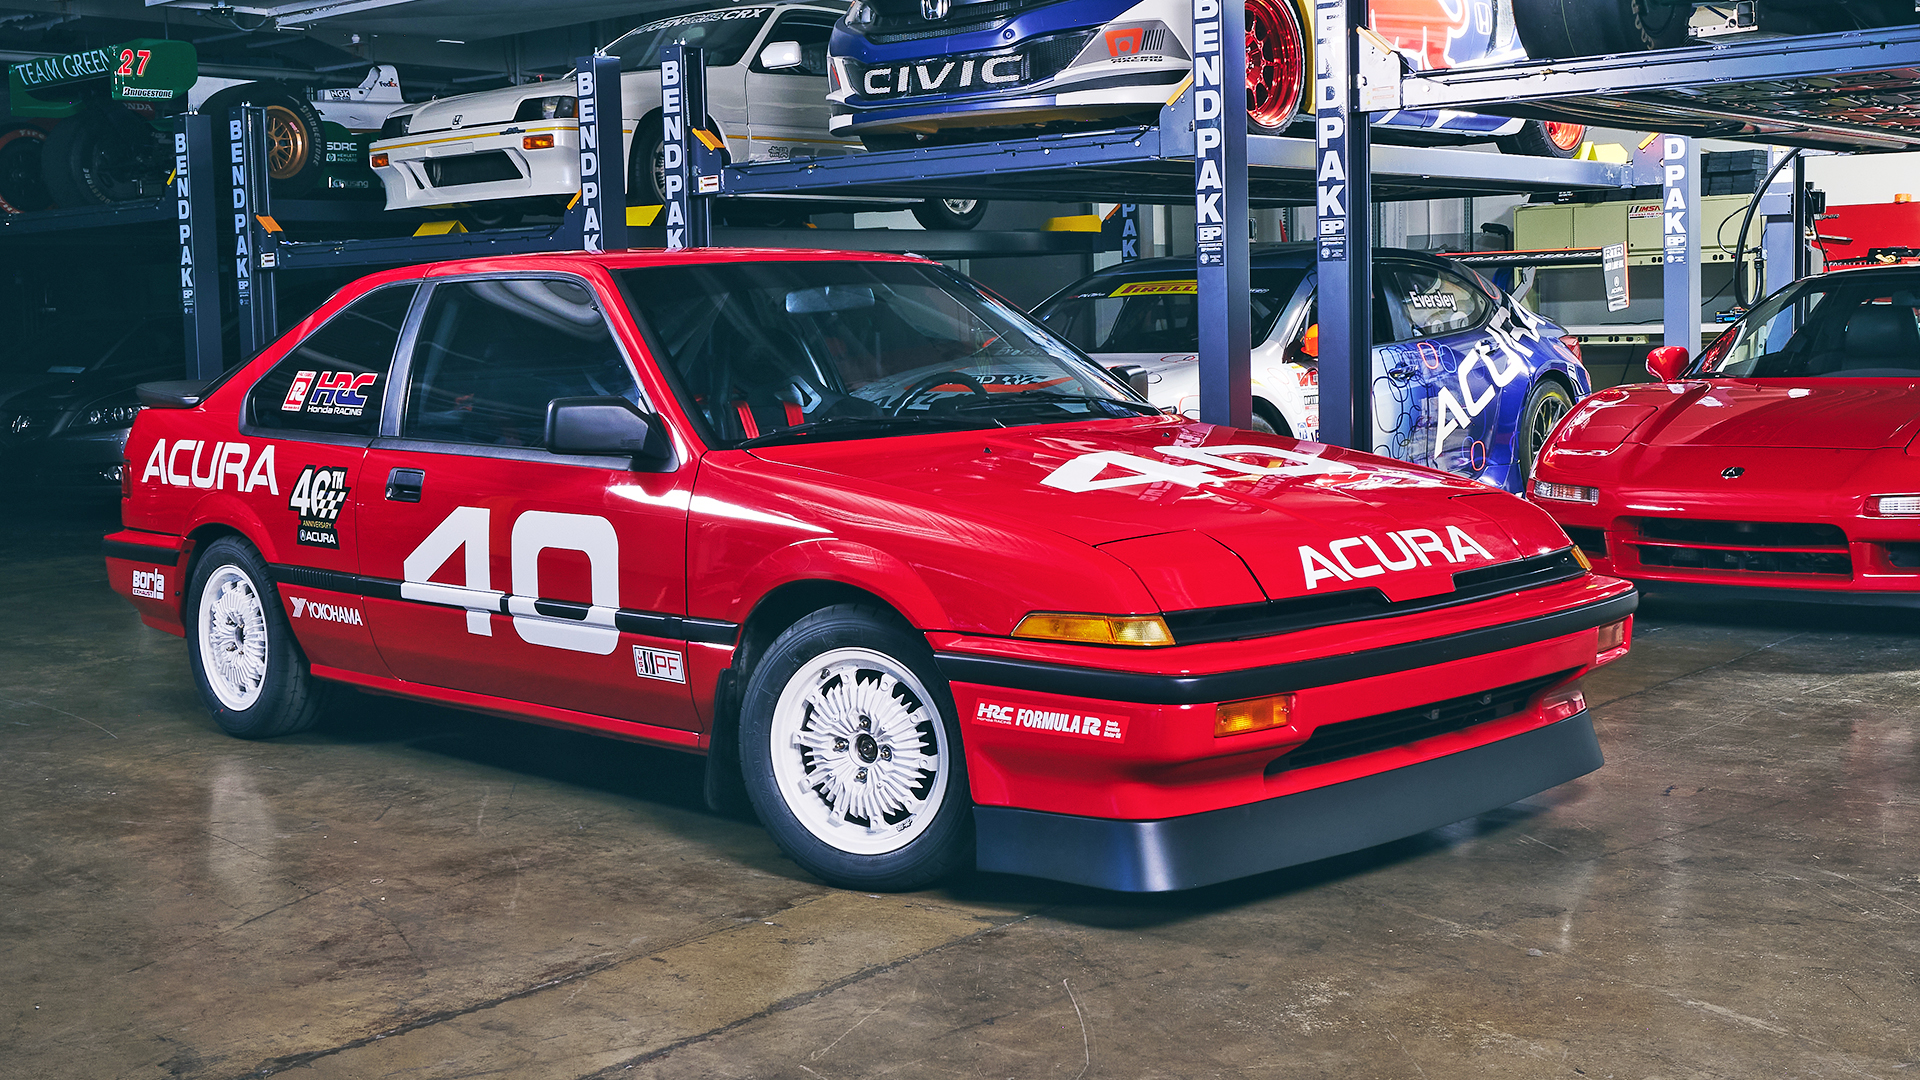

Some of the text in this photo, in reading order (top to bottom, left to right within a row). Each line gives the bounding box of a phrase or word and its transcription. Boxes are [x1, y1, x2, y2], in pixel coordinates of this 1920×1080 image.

[721, 8, 768, 21] CRX
[16, 49, 110, 86] TEAM GREEN
[117, 49, 151, 77] 27
[864, 54, 1023, 94] CIVIC
[123, 87, 173, 99] BRIDGESTONE
[330, 89, 351, 98] NGK
[326, 142, 358, 151] SDRC
[174, 133, 194, 287] BENDPAK
[229, 120, 250, 278] BENDPAK
[1409, 290, 1458, 311] Eversley
[308, 371, 379, 409] HRC
[1434, 293, 1546, 459] ACURA
[307, 405, 333, 414] Honda
[333, 406, 363, 416] RACING
[142, 438, 280, 496] ACURA
[1039, 443, 1359, 493] 40
[302, 520, 332, 529] ANNIVERSARY
[306, 531, 336, 545] ACURA
[1298, 525, 1495, 590] ACURA
[402, 506, 620, 655] 40
[306, 601, 364, 626] YOKOHAMA
[654, 655, 679, 676] PF
[977, 703, 1102, 736] HRC FORMULA R
